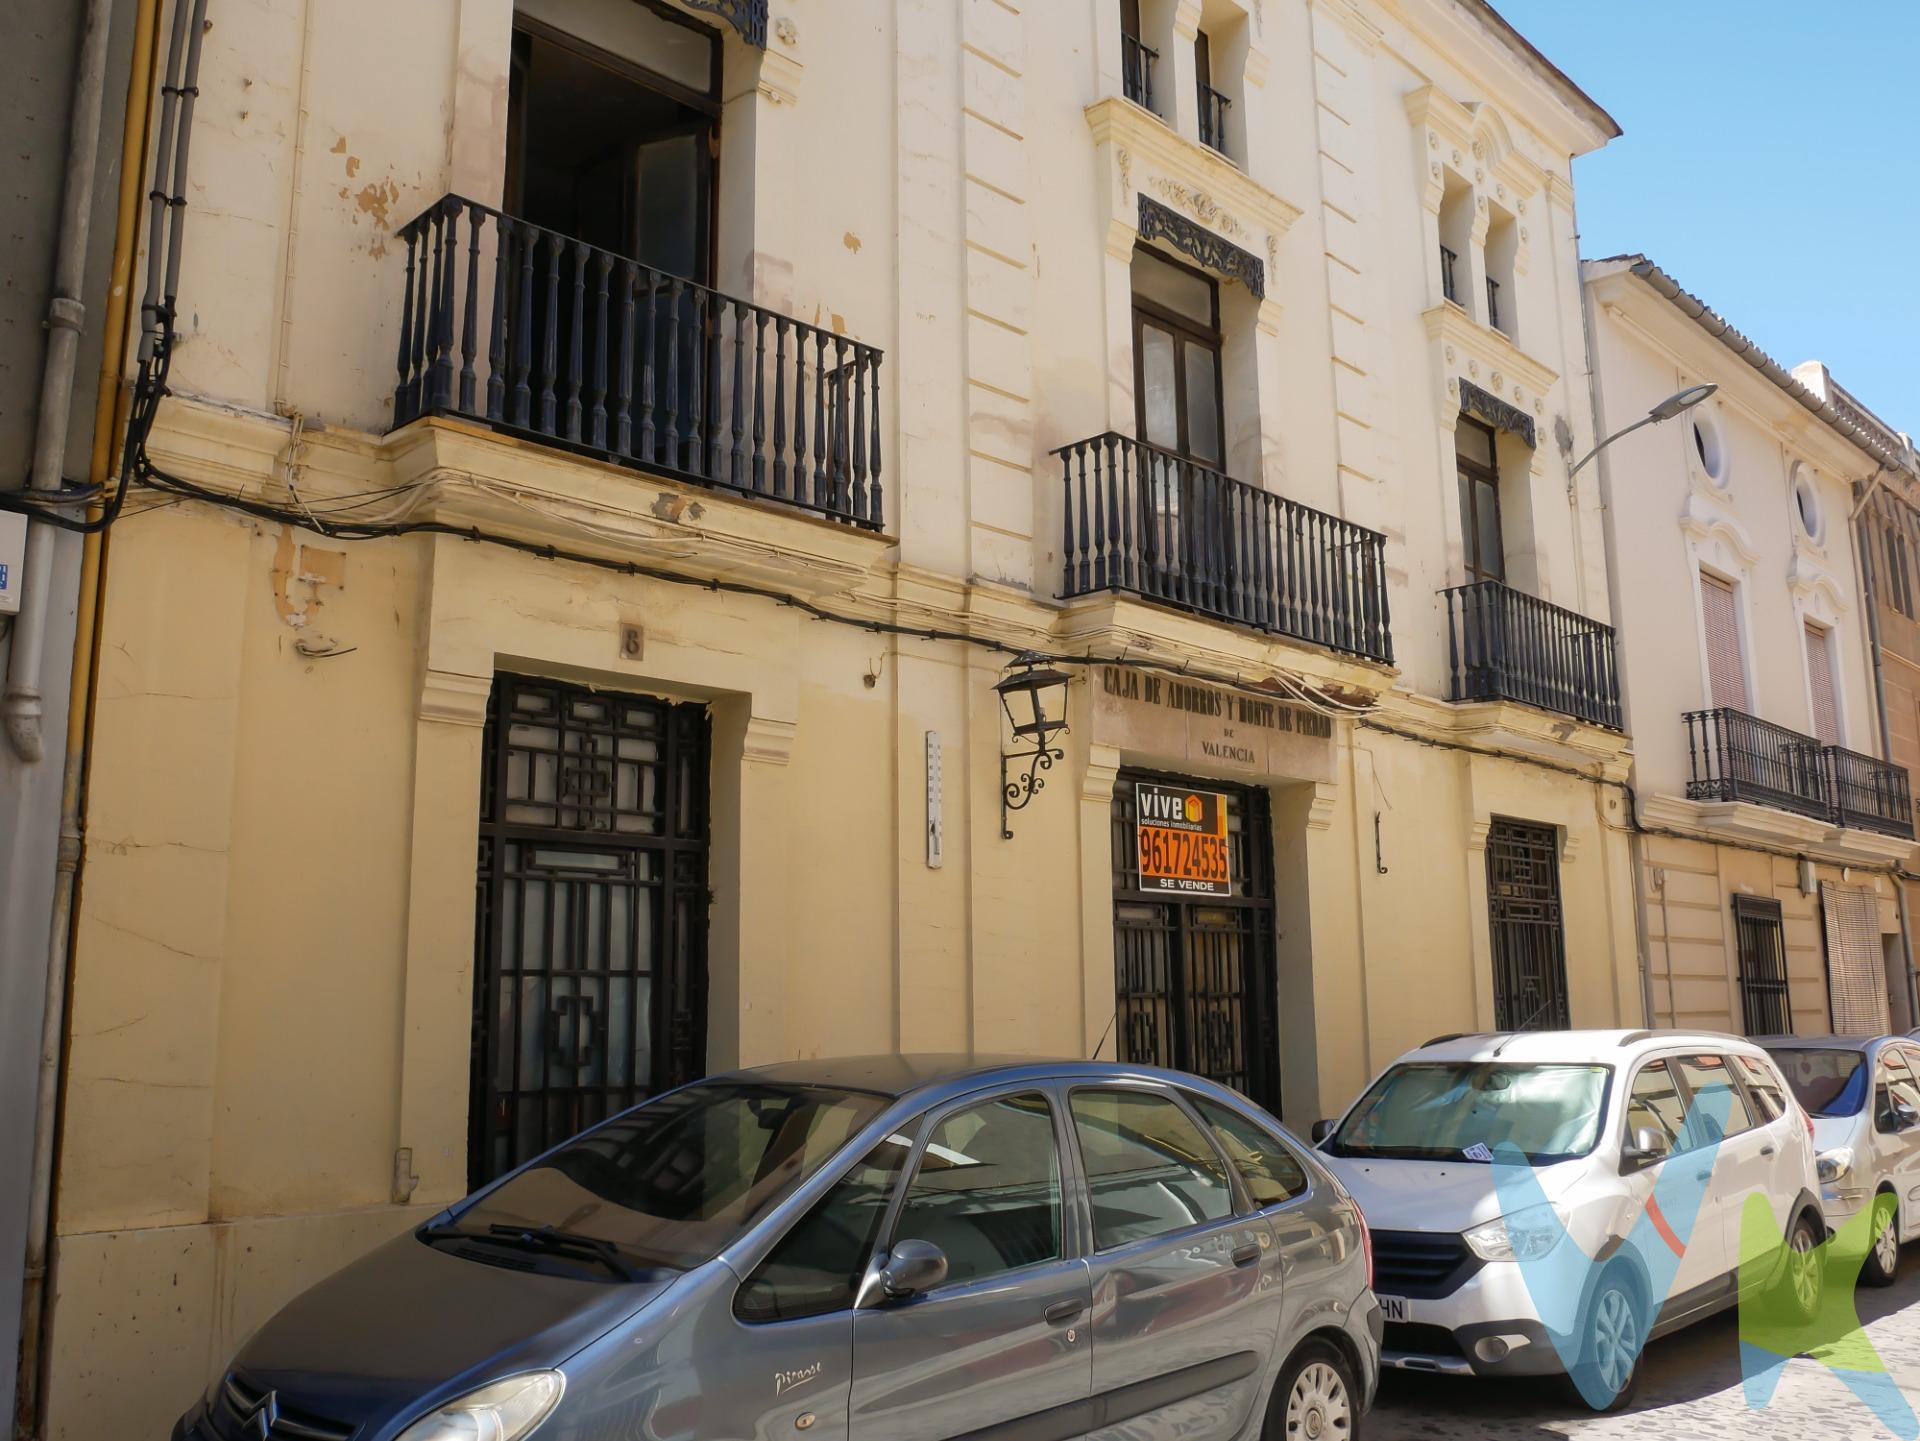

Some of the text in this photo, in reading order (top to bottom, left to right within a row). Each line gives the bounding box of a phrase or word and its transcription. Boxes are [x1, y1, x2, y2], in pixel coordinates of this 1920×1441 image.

[1104, 666, 1139, 701] CAJA
[1144, 675, 1161, 705] DE
[1167, 681, 1222, 717] AHORROS
[1227, 694, 1234, 721] Y
[1239, 696, 1275, 729] MONTE
[1278, 706, 1293, 732] DE
[1224, 728, 1235, 738] DE
[1201, 740, 1256, 763] VALENCIA
[1141, 787, 1183, 820] vive
[1140, 828, 1228, 880] 961724535
[1160, 878, 1215, 891] SE VENDE
